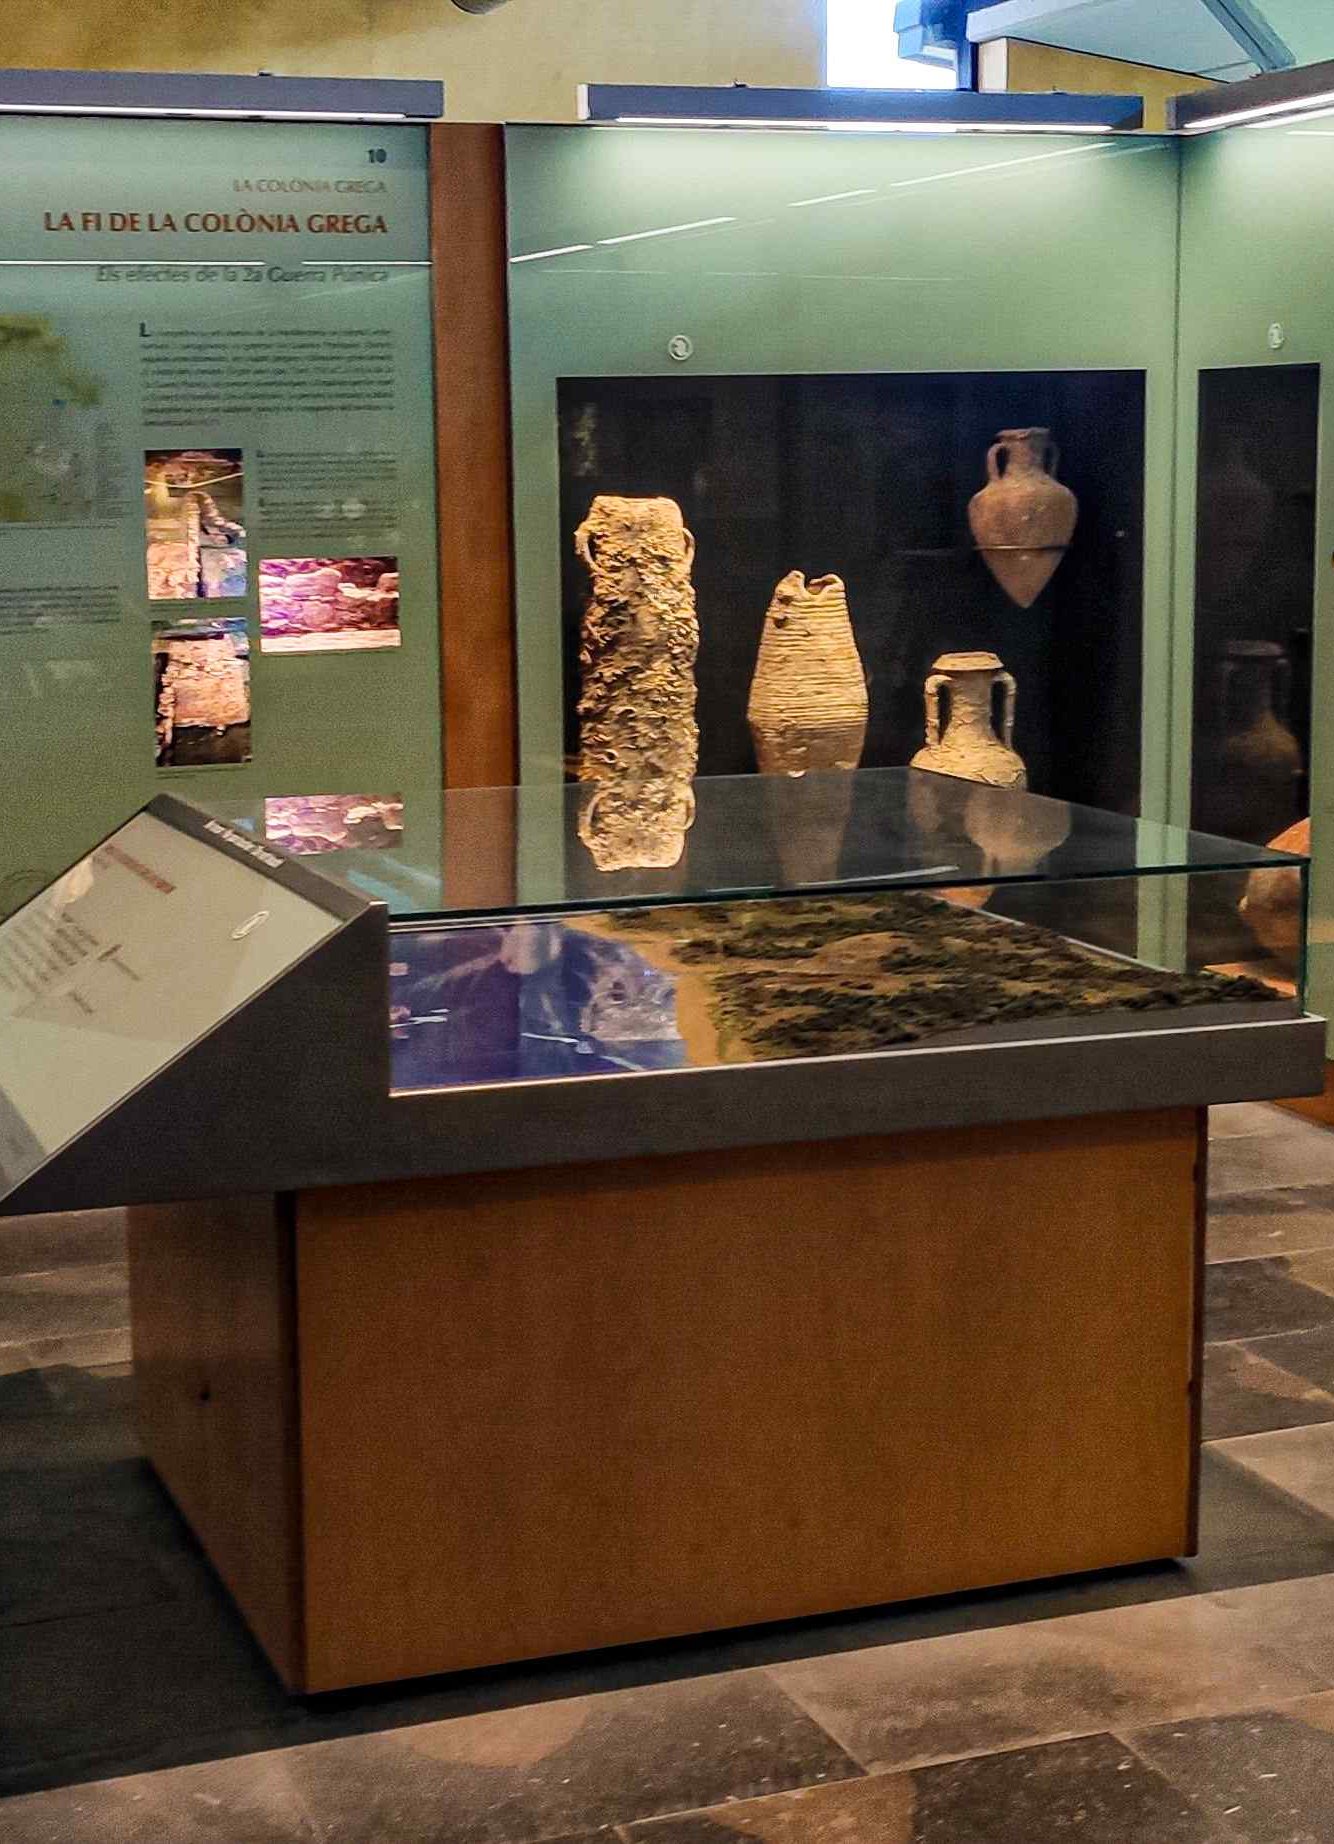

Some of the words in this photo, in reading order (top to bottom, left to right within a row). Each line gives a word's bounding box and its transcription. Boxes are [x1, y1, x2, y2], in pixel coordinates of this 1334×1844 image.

[367, 148, 388, 164] 10
[234, 179, 253, 193] LA
[335, 179, 388, 194] GREGA
[43, 211, 75, 232] LA
[81, 211, 102, 232] FI
[109, 212, 140, 233] DE
[148, 212, 178, 233] LA
[183, 208, 301, 234] COLÒNIA
[307, 213, 388, 235] GREGA
[195, 265, 218, 283] de
